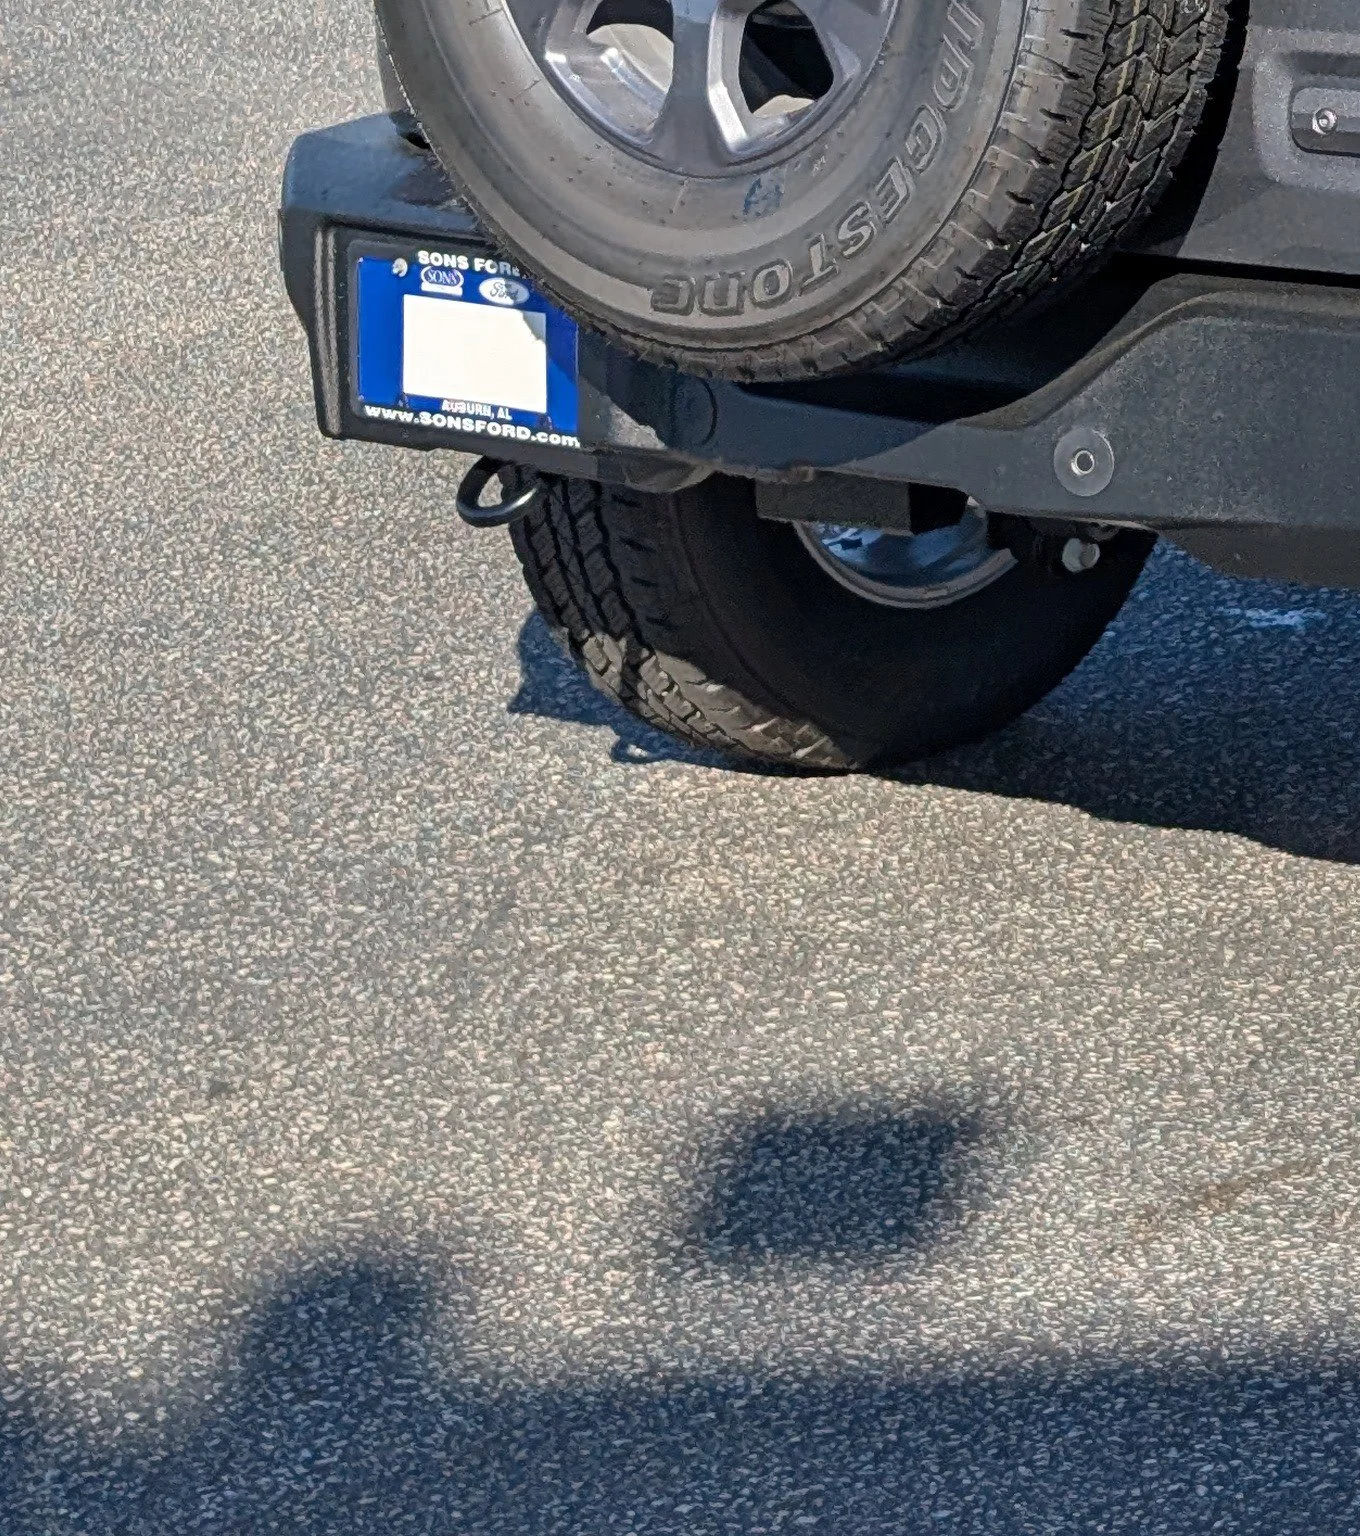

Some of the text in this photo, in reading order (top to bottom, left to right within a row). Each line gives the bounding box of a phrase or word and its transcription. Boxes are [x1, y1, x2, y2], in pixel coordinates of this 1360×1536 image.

[417, 250, 469, 270] SONS
[441, 399, 513, 421] AUBURN, AL
[364, 404, 581, 448] www.SONSFORD.com
